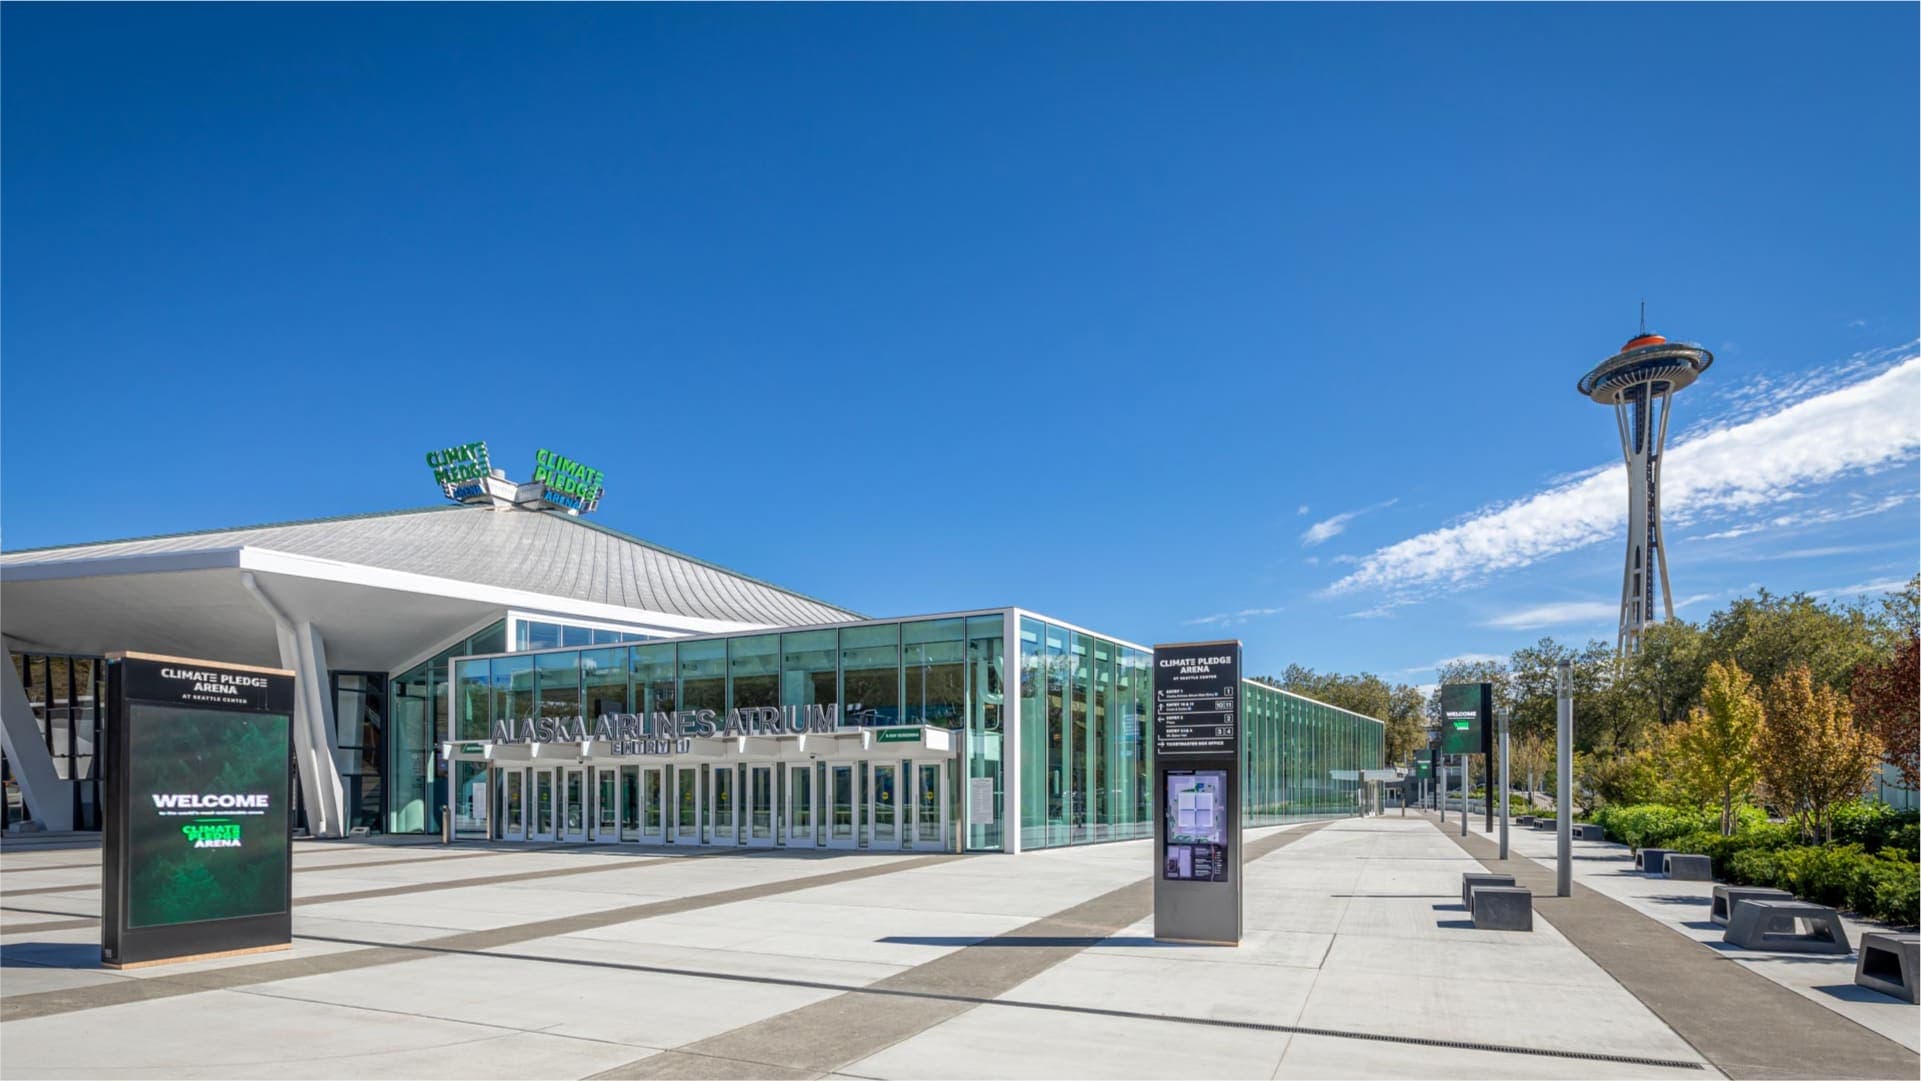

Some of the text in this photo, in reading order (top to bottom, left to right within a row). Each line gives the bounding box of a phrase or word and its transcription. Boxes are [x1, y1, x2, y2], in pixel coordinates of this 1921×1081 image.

[426, 441, 488, 468] CLIMATE
[535, 448, 604, 486] CLIMATE
[533, 465, 598, 503] PLEDGE
[1160, 656, 1232, 667] CLIMATE PLEDGE
[1180, 665, 1210, 674] ARENA
[161, 668, 268, 688] CLIMATE PLEDGE
[193, 682, 238, 695] ARENA
[193, 694, 221, 702] SEATTLE
[222, 696, 248, 704] CENTER
[491, 703, 838, 744] ALASKA AIRLINES ATRIUM
[611, 737, 691, 755] ENTRY 1
[152, 794, 269, 808] WELCOME
[182, 825, 241, 834] CLIMATE
[188, 832, 241, 841] PLEDGE
[194, 839, 242, 848] ARENA
